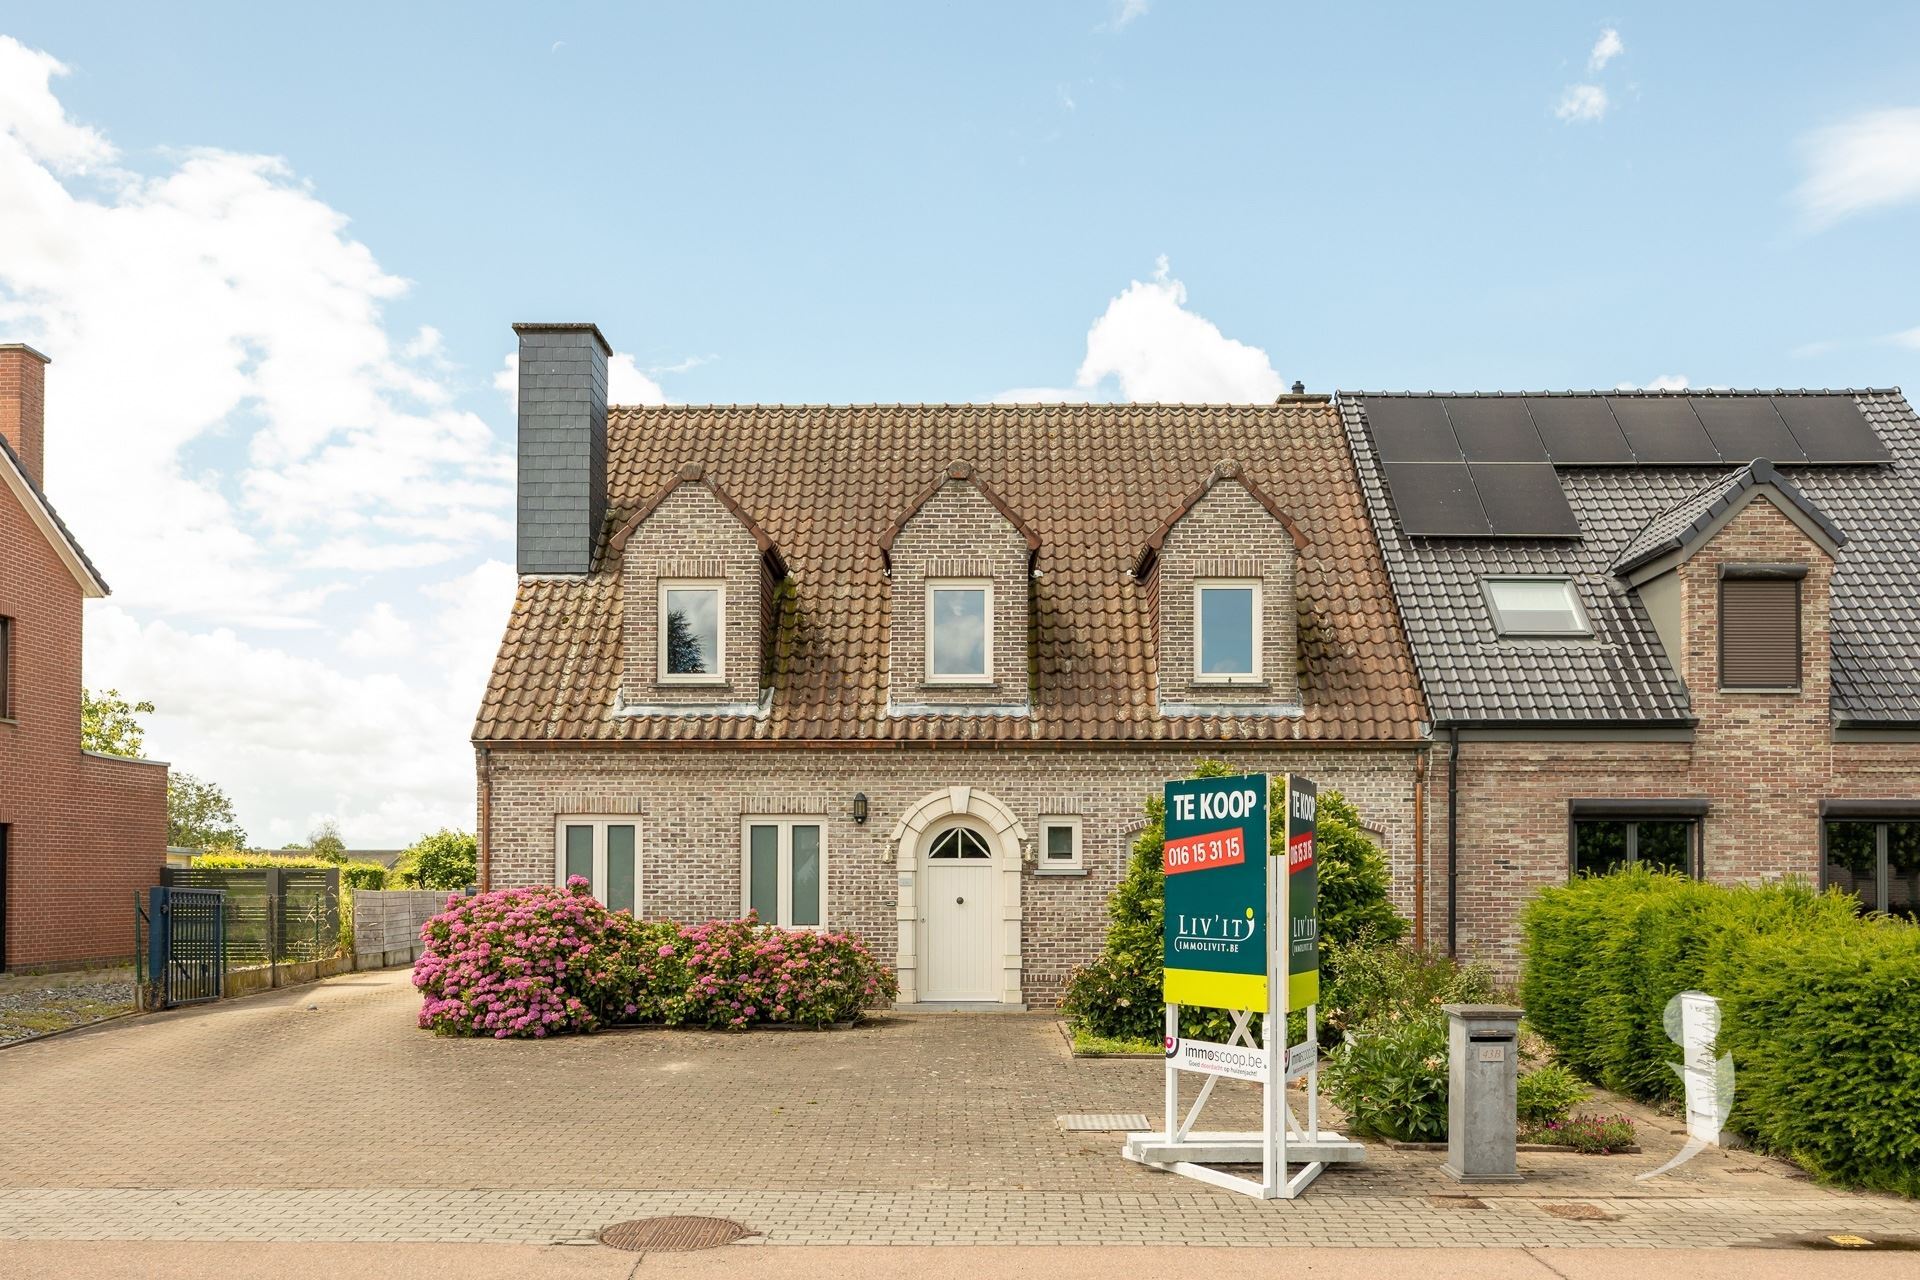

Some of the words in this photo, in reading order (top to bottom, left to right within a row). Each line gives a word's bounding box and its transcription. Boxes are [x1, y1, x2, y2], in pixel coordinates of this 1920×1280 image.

[1173, 794, 1195, 820] TE
[1200, 790, 1257, 819] KOOP
[1292, 790, 1300, 818] TE
[1300, 792, 1315, 821] KOOP
[1168, 846, 1189, 866] 016
[1192, 843, 1206, 863] 15
[1209, 840, 1222, 860] 31
[1226, 837, 1240, 858] 15
[1179, 941, 1239, 953] IMMOLIVIT.BE
[1185, 1043, 1263, 1069] immoscoop.be
